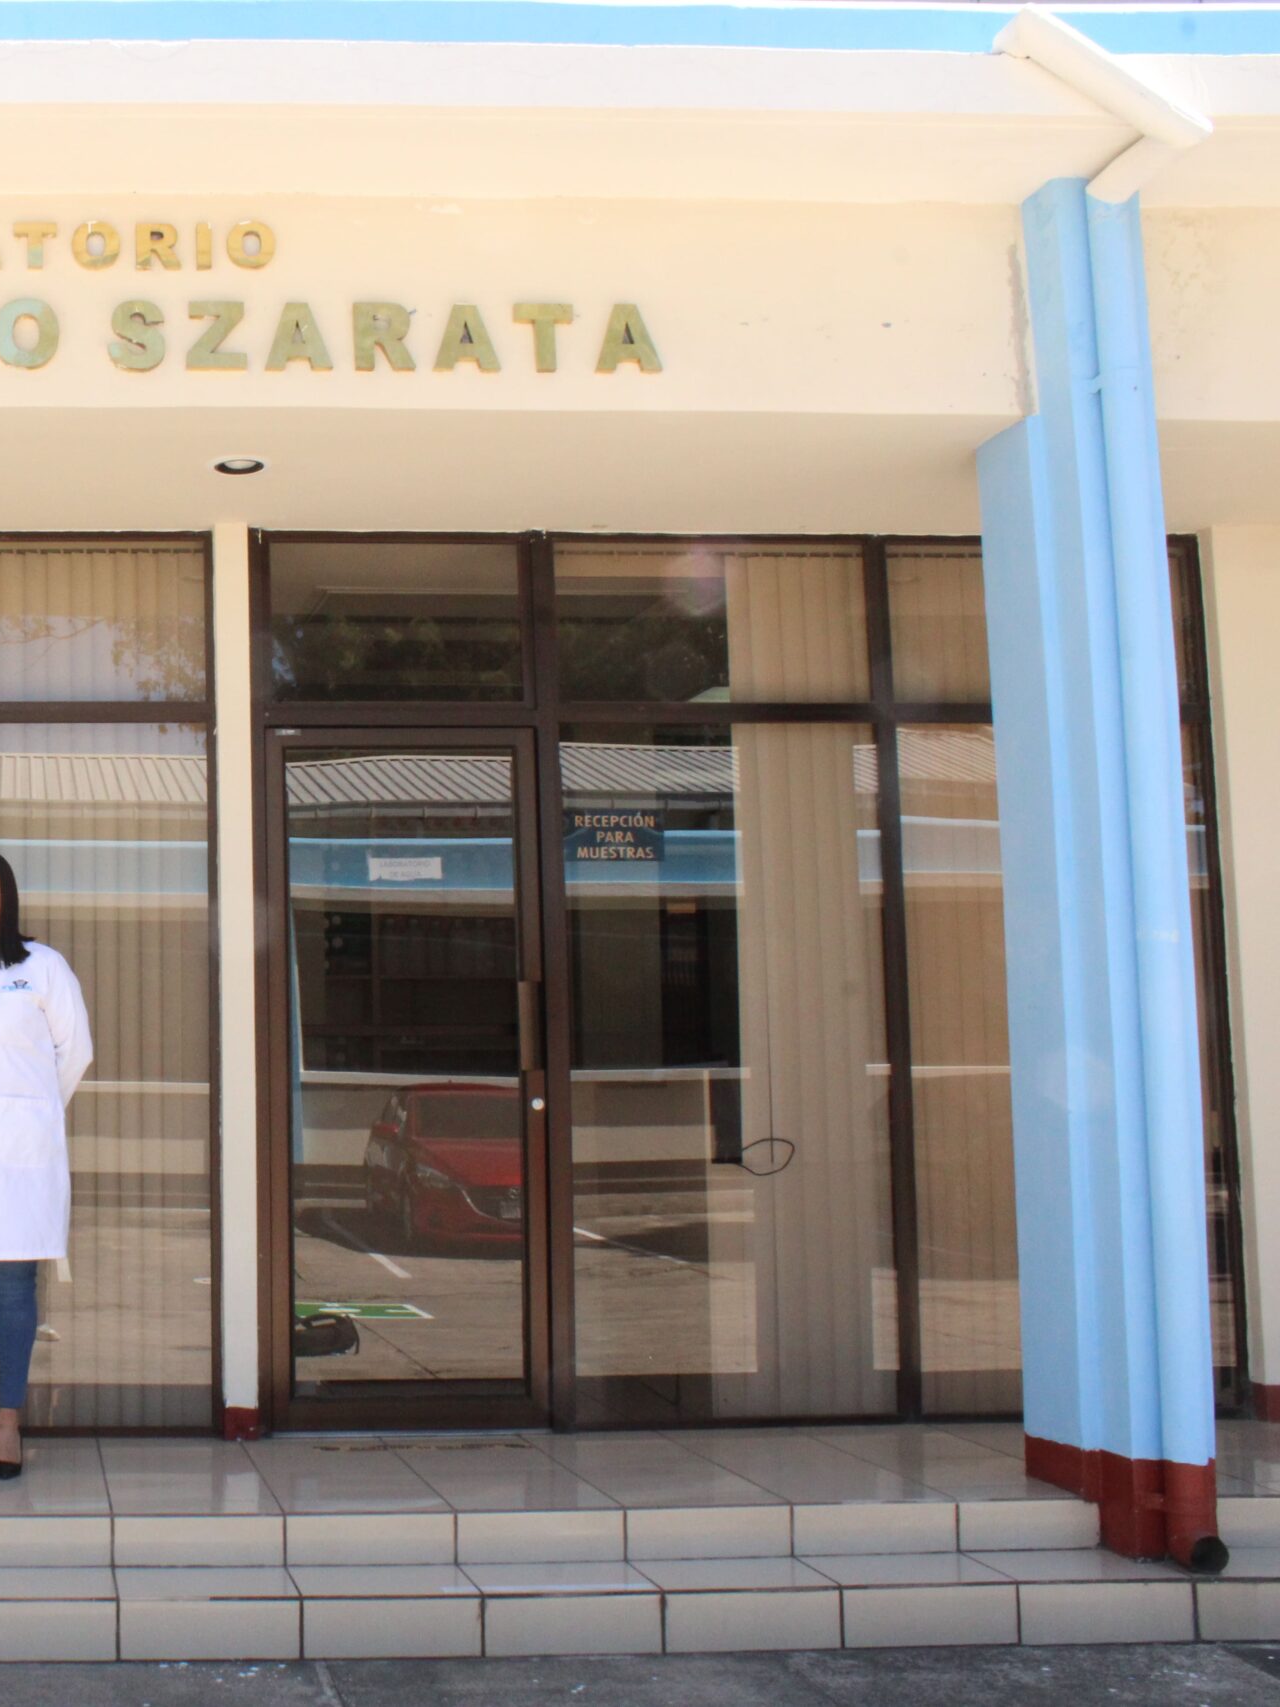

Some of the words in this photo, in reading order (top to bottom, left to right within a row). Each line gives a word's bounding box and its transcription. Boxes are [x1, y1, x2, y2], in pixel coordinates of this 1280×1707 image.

[106, 299, 665, 374] SZARATA
[574, 812, 655, 828] RECEPCIÓN
[595, 830, 635, 844] PARA
[576, 846, 656, 859] MUESTRAS
